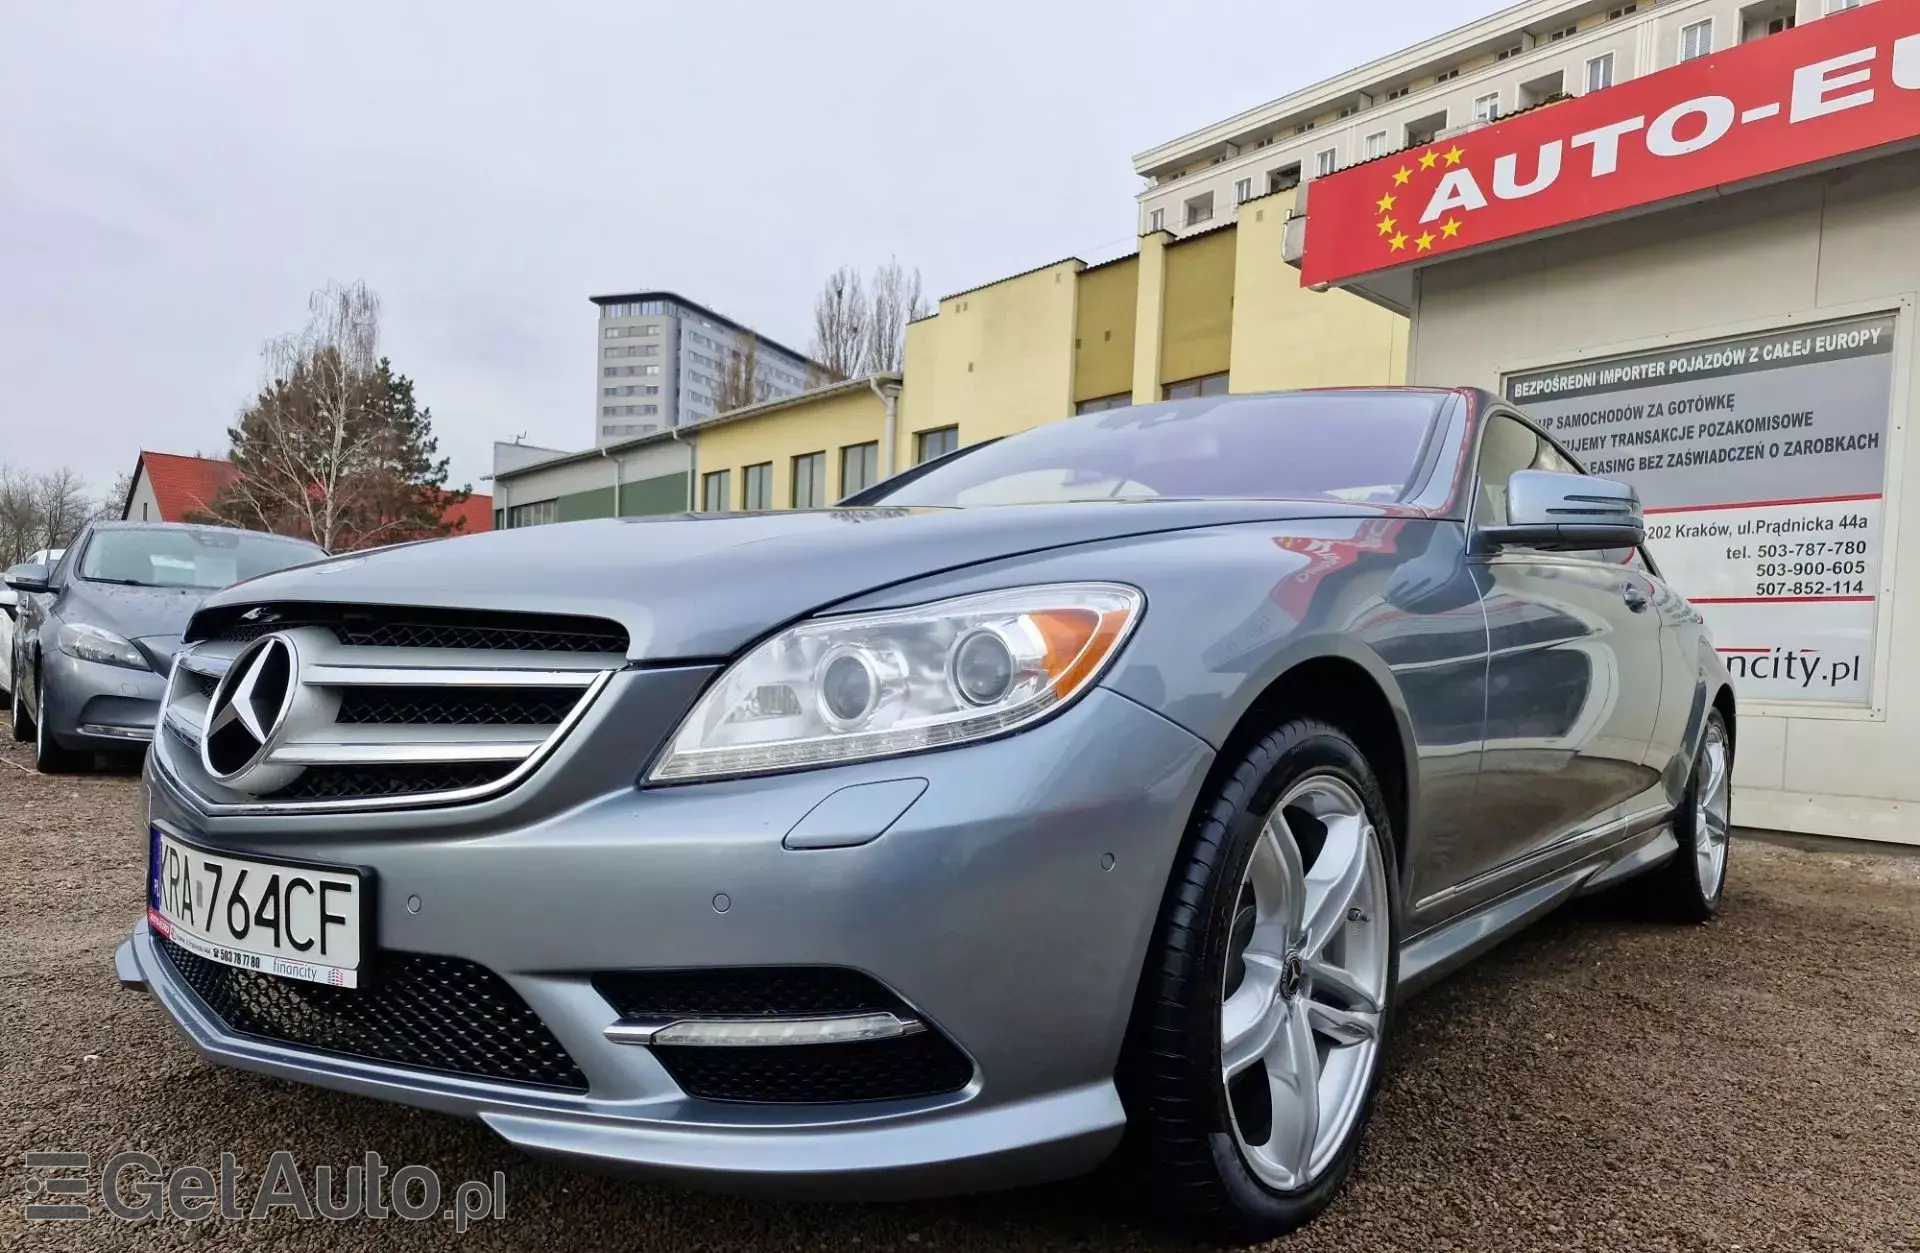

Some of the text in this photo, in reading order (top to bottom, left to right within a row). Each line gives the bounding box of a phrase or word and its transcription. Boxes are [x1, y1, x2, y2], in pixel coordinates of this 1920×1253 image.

[1514, 327, 1882, 398] BEZPOŚREDNI IMPORTER POJAZDÓW Z CAŁEJ EUROPY
[1556, 405, 1644, 430] SAMOCHODÓW
[1647, 403, 1664, 418] ZA
[1668, 393, 1736, 416] GOTÓWKĘ
[1562, 411, 1814, 452] UJEMY TRANSAKCJE POZAKOMISOWE
[1638, 455, 1663, 471] BEZ
[1667, 441, 1765, 467] ZAŚWIADCZEŃ
[1769, 443, 1780, 458] O
[1783, 433, 1879, 457] ZAROBKACH
[1675, 522, 1732, 538] Kraków,
[1737, 516, 1834, 537] ul.Prądnicka
[1839, 514, 1868, 530] 44a
[1726, 541, 1867, 560] tel. 503-787-780
[1756, 560, 1865, 577] 503-900-605
[1756, 580, 1864, 596] 507-852-114
[203, 862, 352, 955] 764CF
